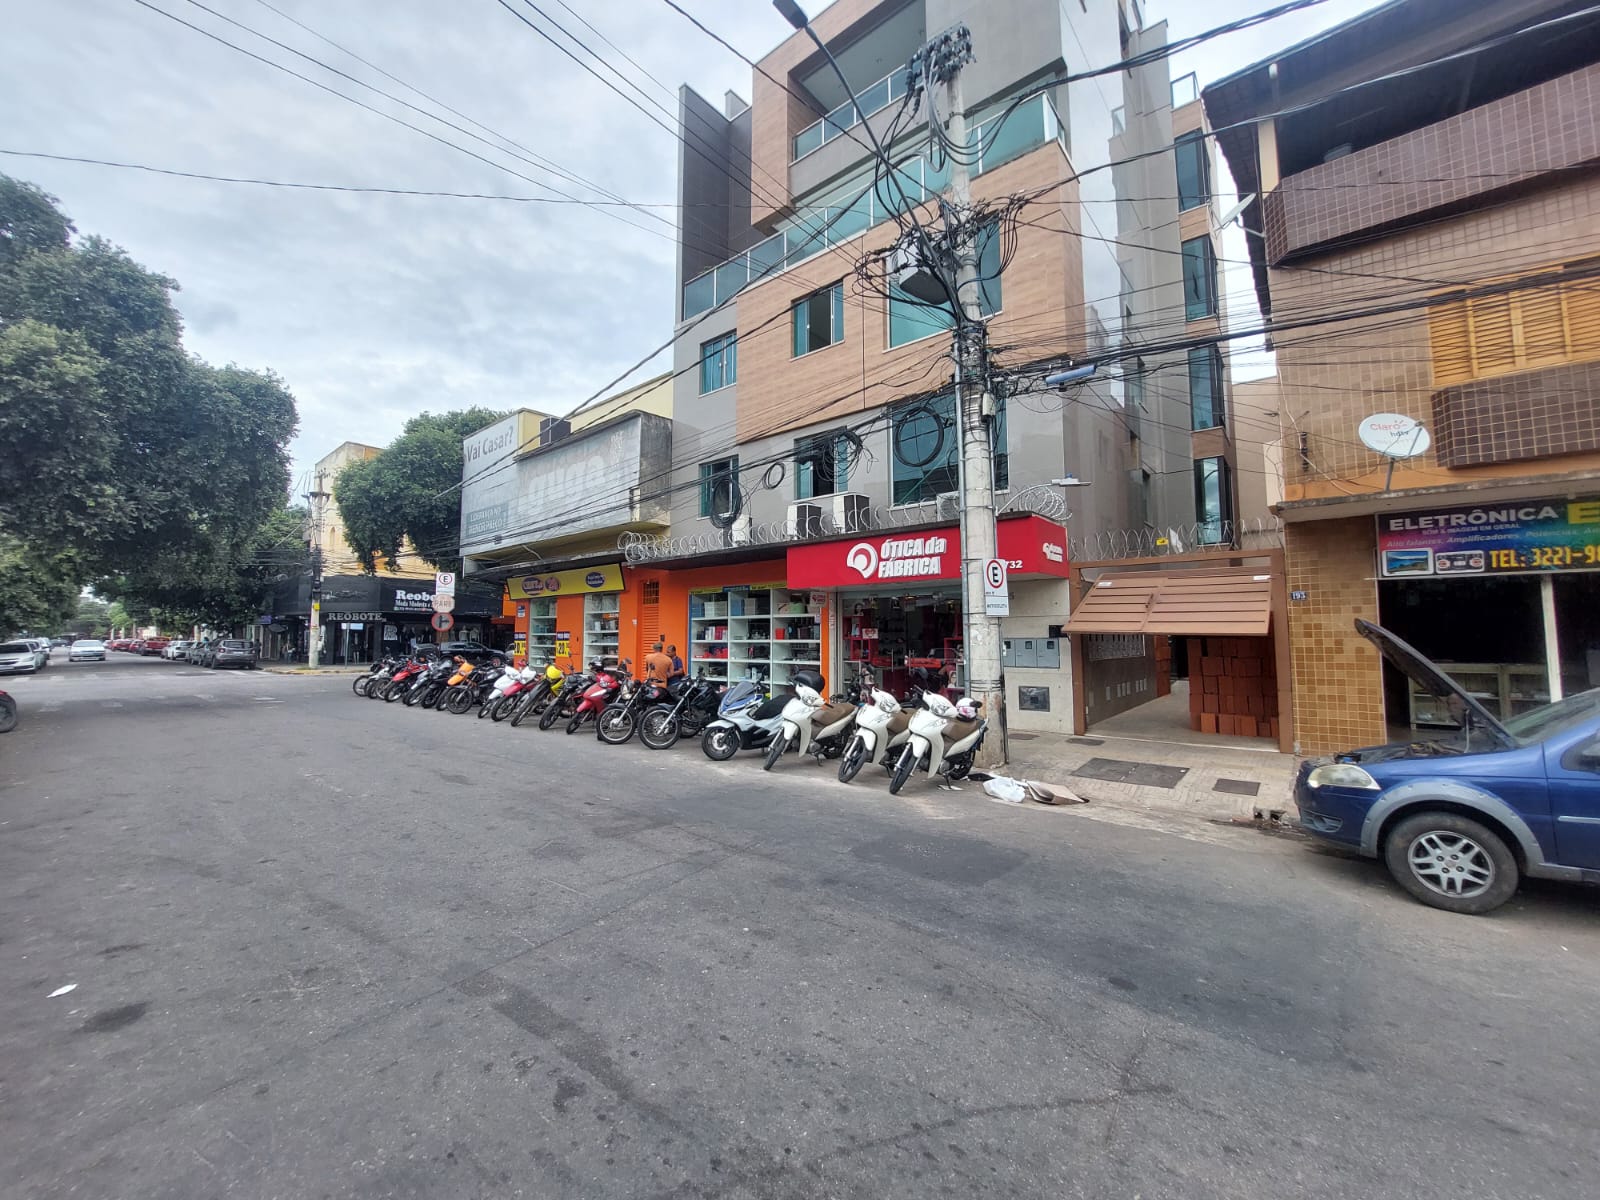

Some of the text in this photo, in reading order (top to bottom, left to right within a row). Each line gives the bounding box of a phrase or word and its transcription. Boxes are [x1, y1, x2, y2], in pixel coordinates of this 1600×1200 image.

[467, 425, 513, 462] Vai Casar?
[1389, 506, 1559, 532] ELETRÔNICA
[881, 537, 947, 559] ÓTICA da
[878, 557, 942, 578] FÁBRICA
[1489, 549, 1526, 568] TEL:
[443, 575, 449, 583] E
[992, 566, 999, 583] E
[328, 612, 382, 621] REOBOTE
